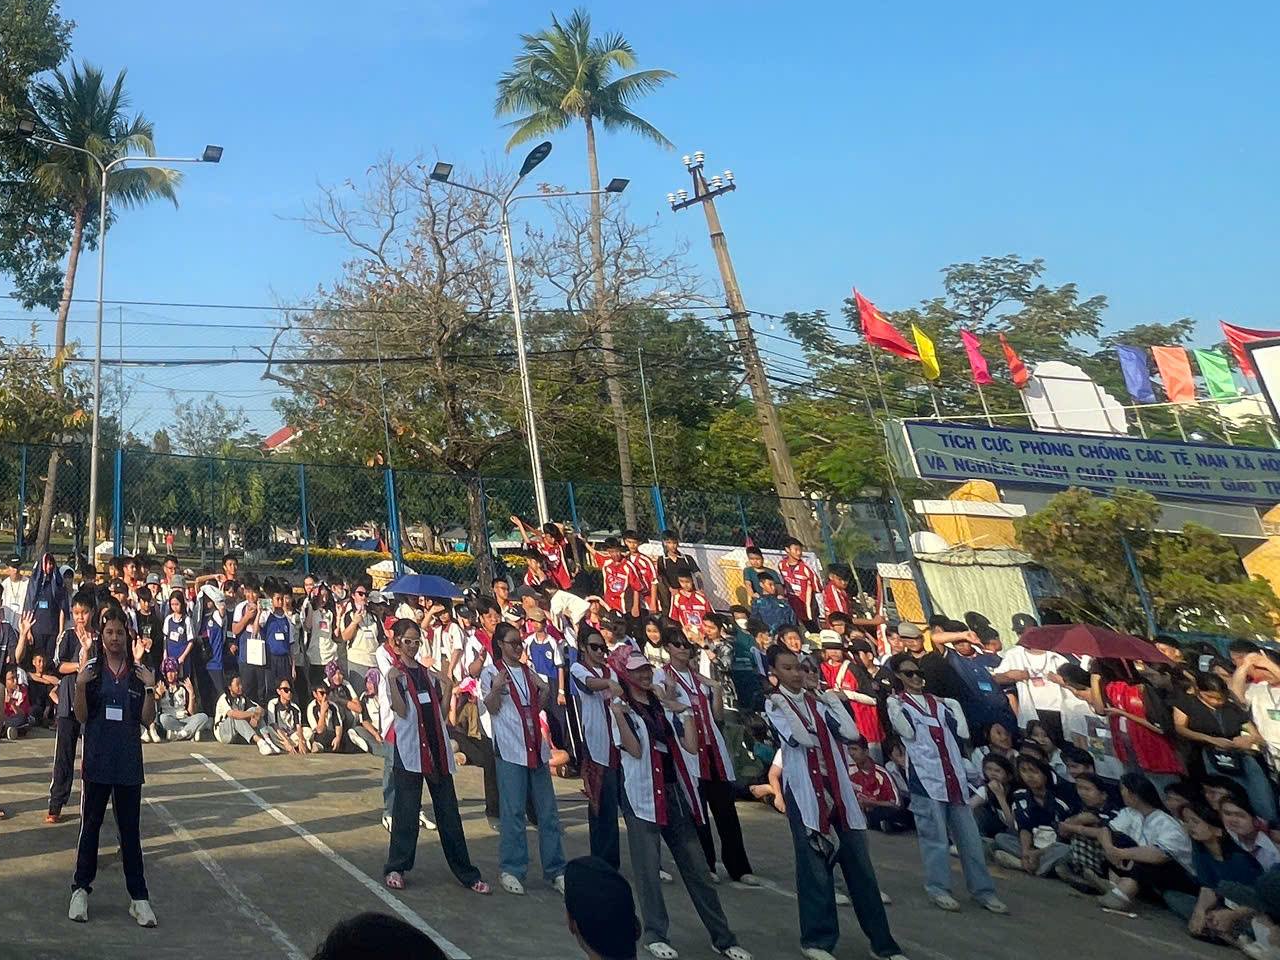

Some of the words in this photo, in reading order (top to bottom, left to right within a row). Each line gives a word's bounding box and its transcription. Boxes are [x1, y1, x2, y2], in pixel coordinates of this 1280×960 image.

[925, 452, 948, 471] VÀ
[937, 430, 977, 450] TÍCH
[982, 433, 1014, 455] CỰC
[1020, 437, 1074, 458] PHÒNG
[1078, 441, 1132, 462] CHỐNG
[1135, 446, 1166, 465] CÁC
[1170, 448, 1192, 469] TỆ
[1195, 452, 1229, 471] NẠN
